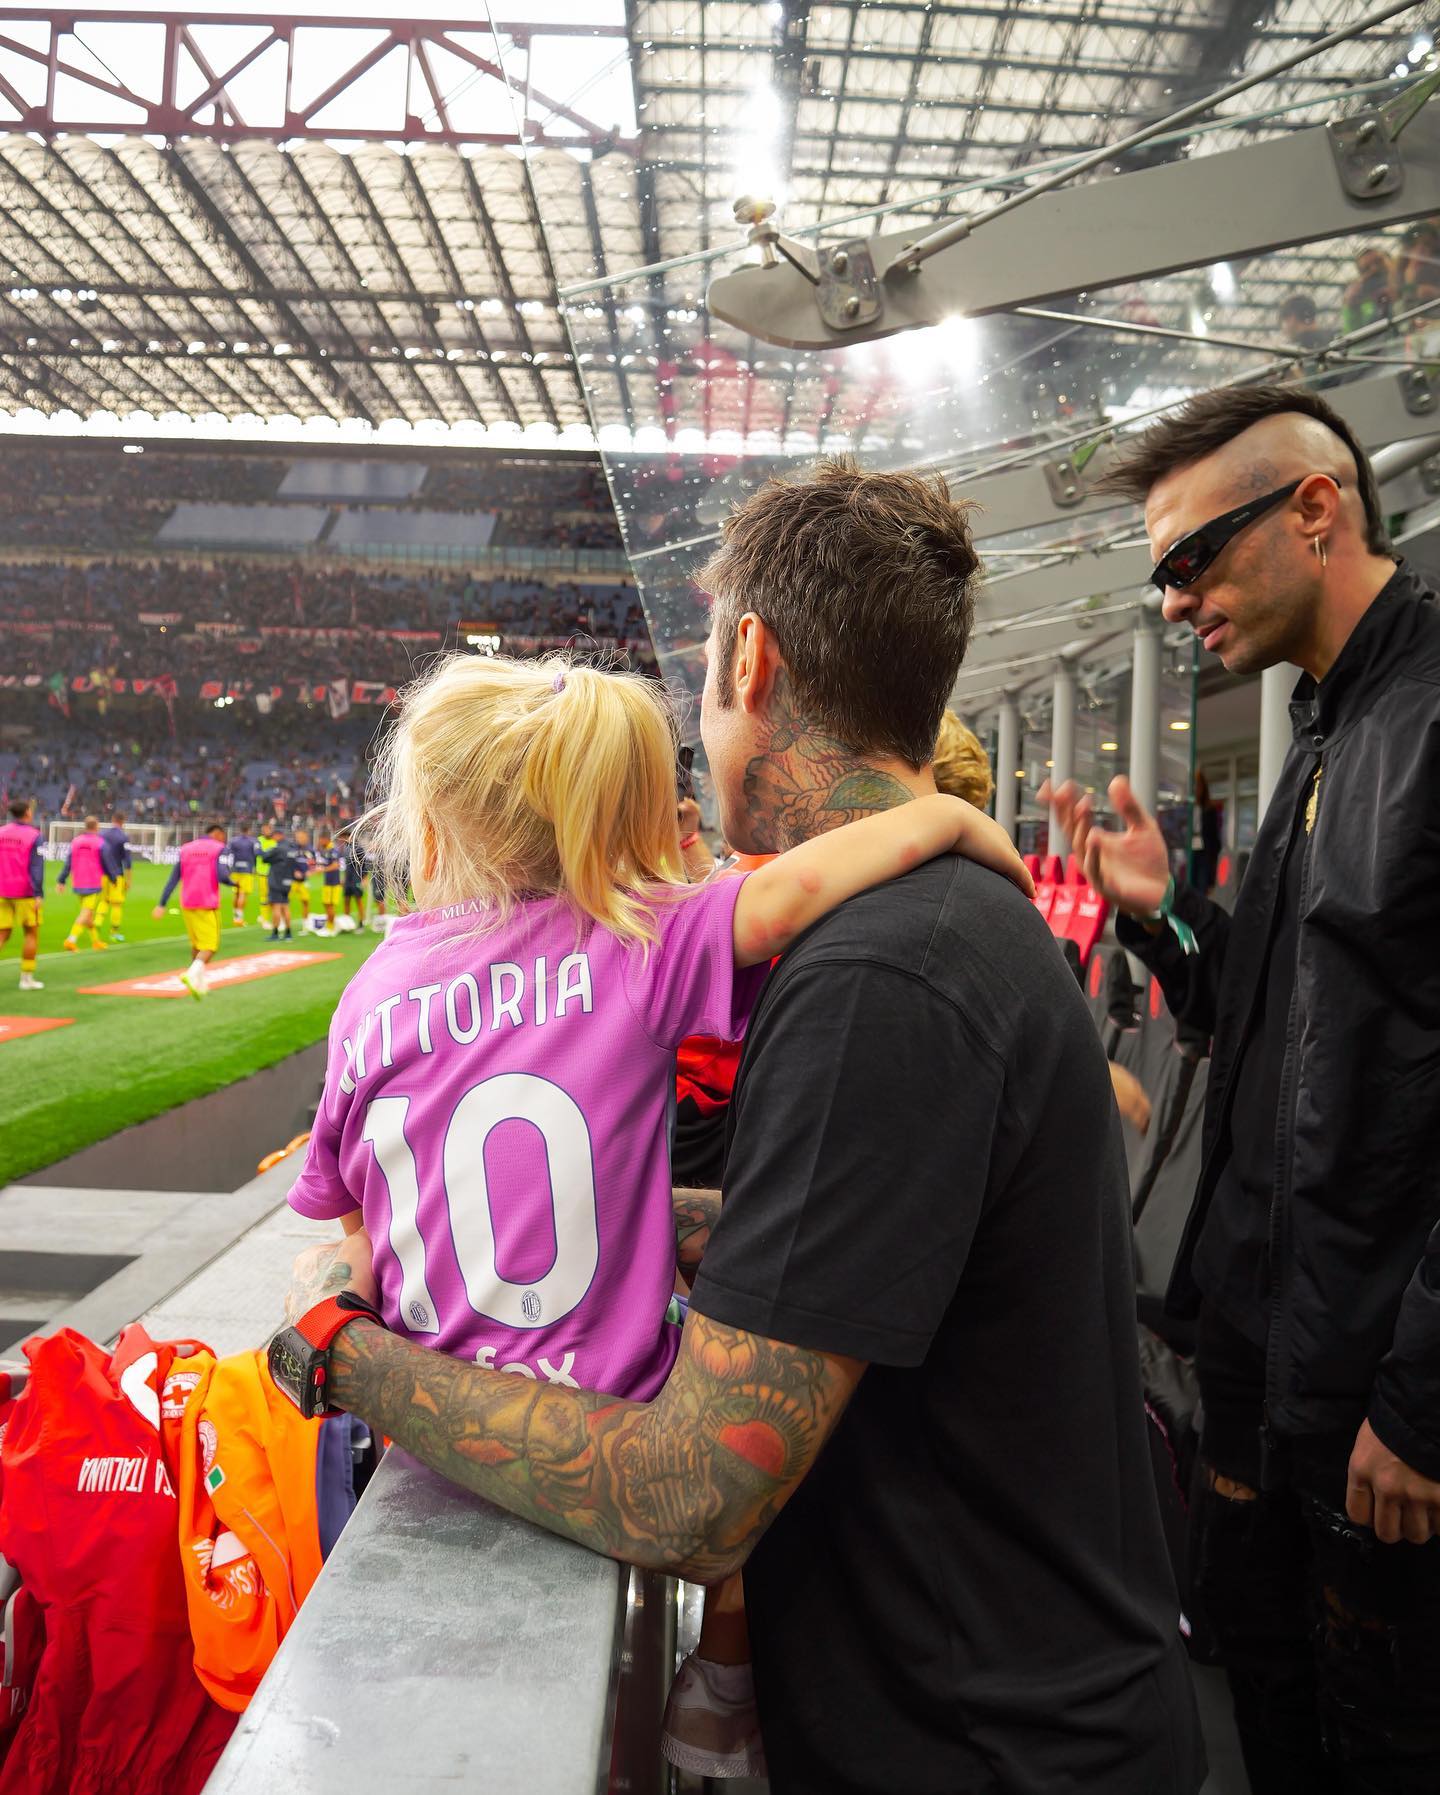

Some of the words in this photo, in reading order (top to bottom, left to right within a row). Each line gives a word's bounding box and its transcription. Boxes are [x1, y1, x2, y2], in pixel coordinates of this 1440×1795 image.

[441, 898, 490, 920] MILAN
[339, 952, 593, 1096] VITTORIA
[363, 1072, 599, 1334] 10
[77, 1456, 148, 1493] ITALIANA
